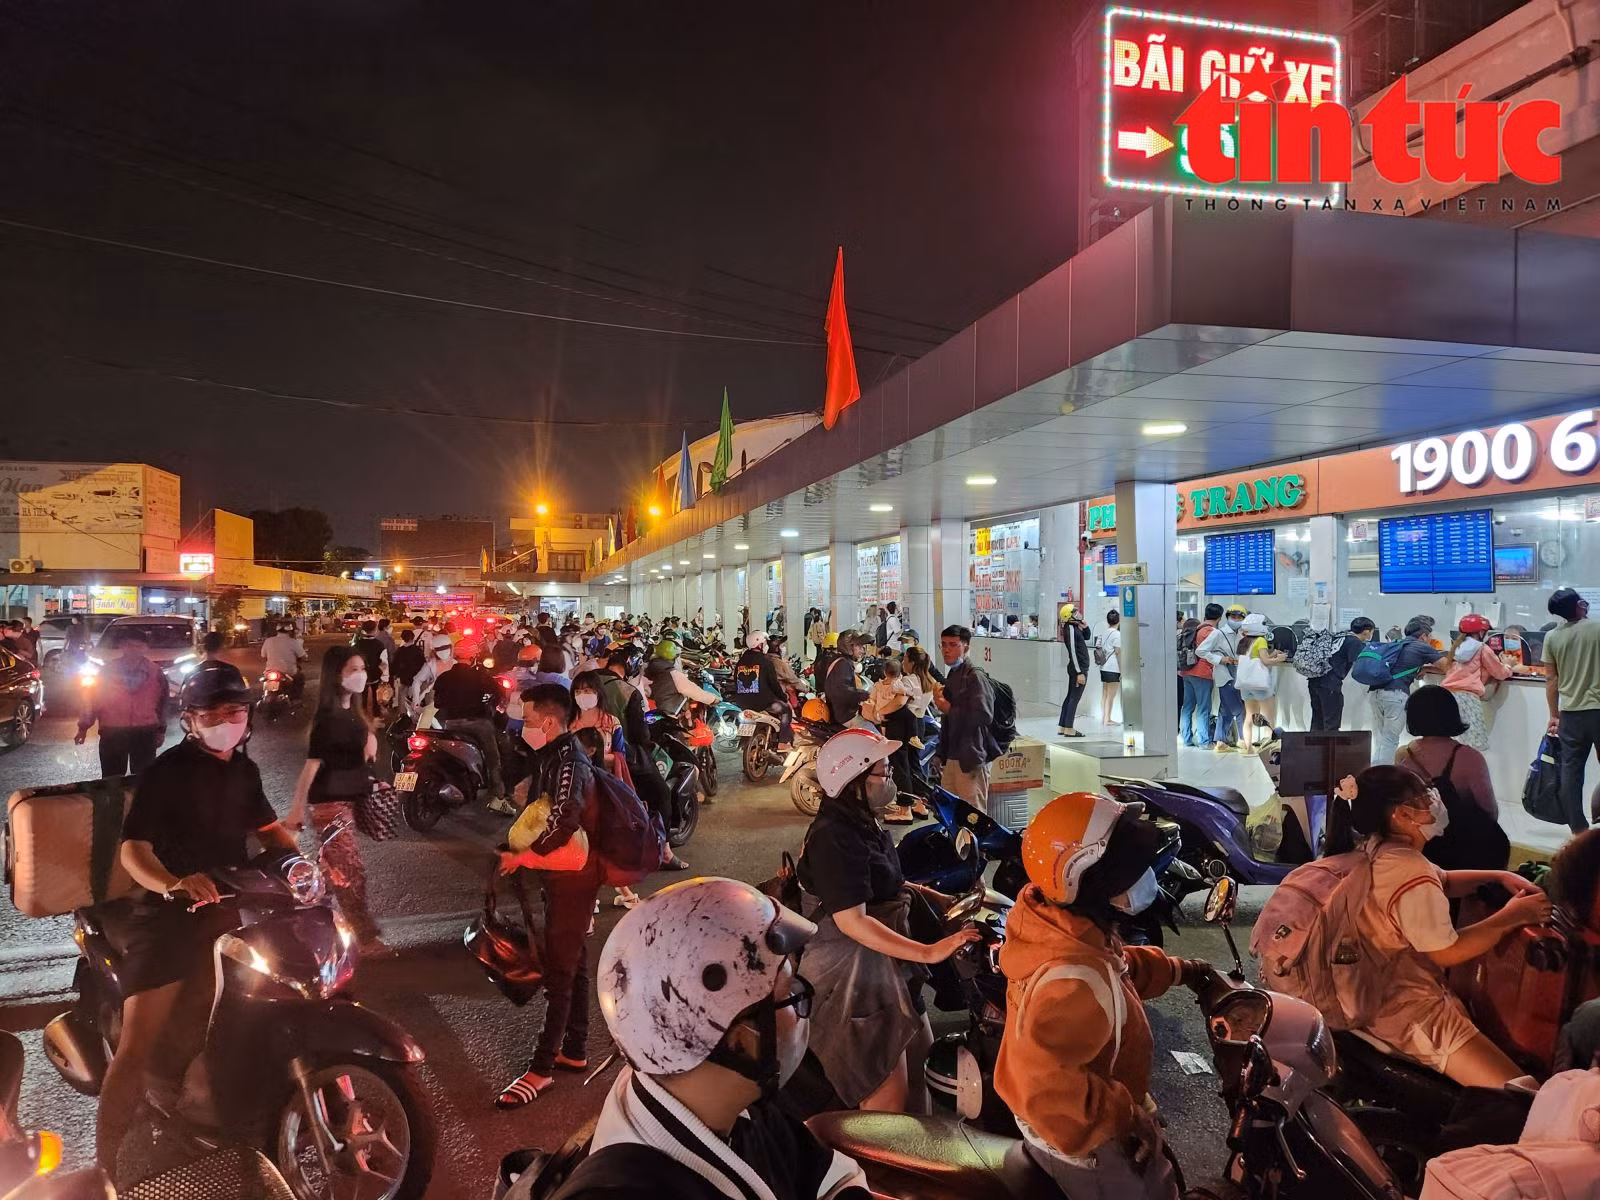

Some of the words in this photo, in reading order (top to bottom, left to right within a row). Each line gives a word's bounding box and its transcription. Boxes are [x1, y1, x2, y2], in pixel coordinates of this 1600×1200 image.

[1113, 33, 1184, 93] BÃI
[1283, 60, 1334, 107] XE
[1391, 423, 1534, 493] 1900
[1550, 410, 1597, 472] 6
[1190, 474, 1302, 518] TRANG
[984, 646, 992, 662] 31
